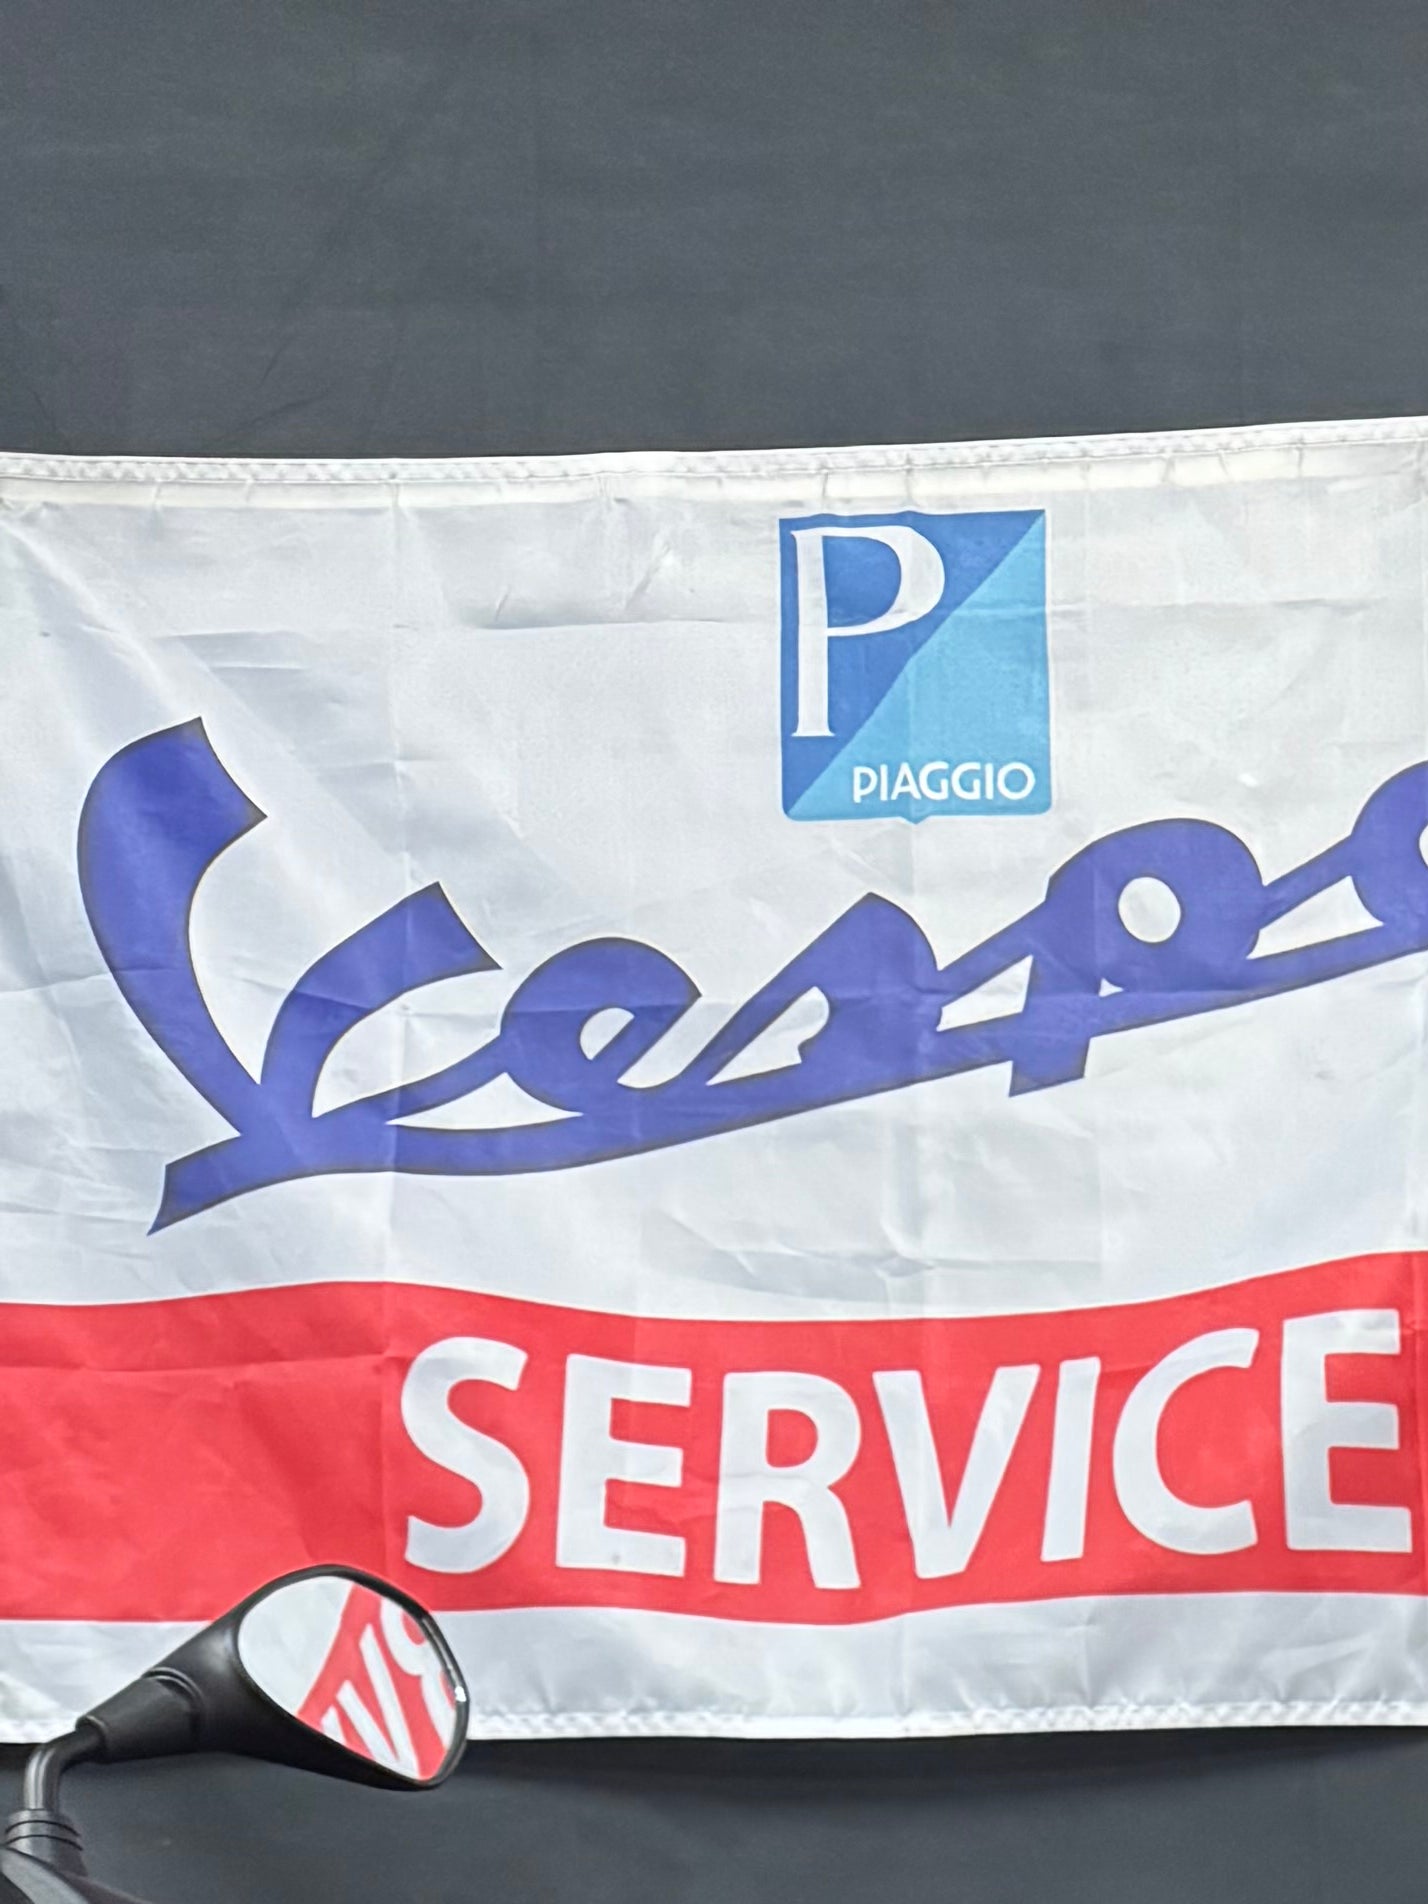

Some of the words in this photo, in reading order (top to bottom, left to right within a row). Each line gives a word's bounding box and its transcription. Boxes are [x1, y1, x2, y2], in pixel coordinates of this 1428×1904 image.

[791, 524, 946, 737] P
[852, 761, 1036, 804] PIAGGIO
[398, 1308, 1415, 1592] SERVICE
